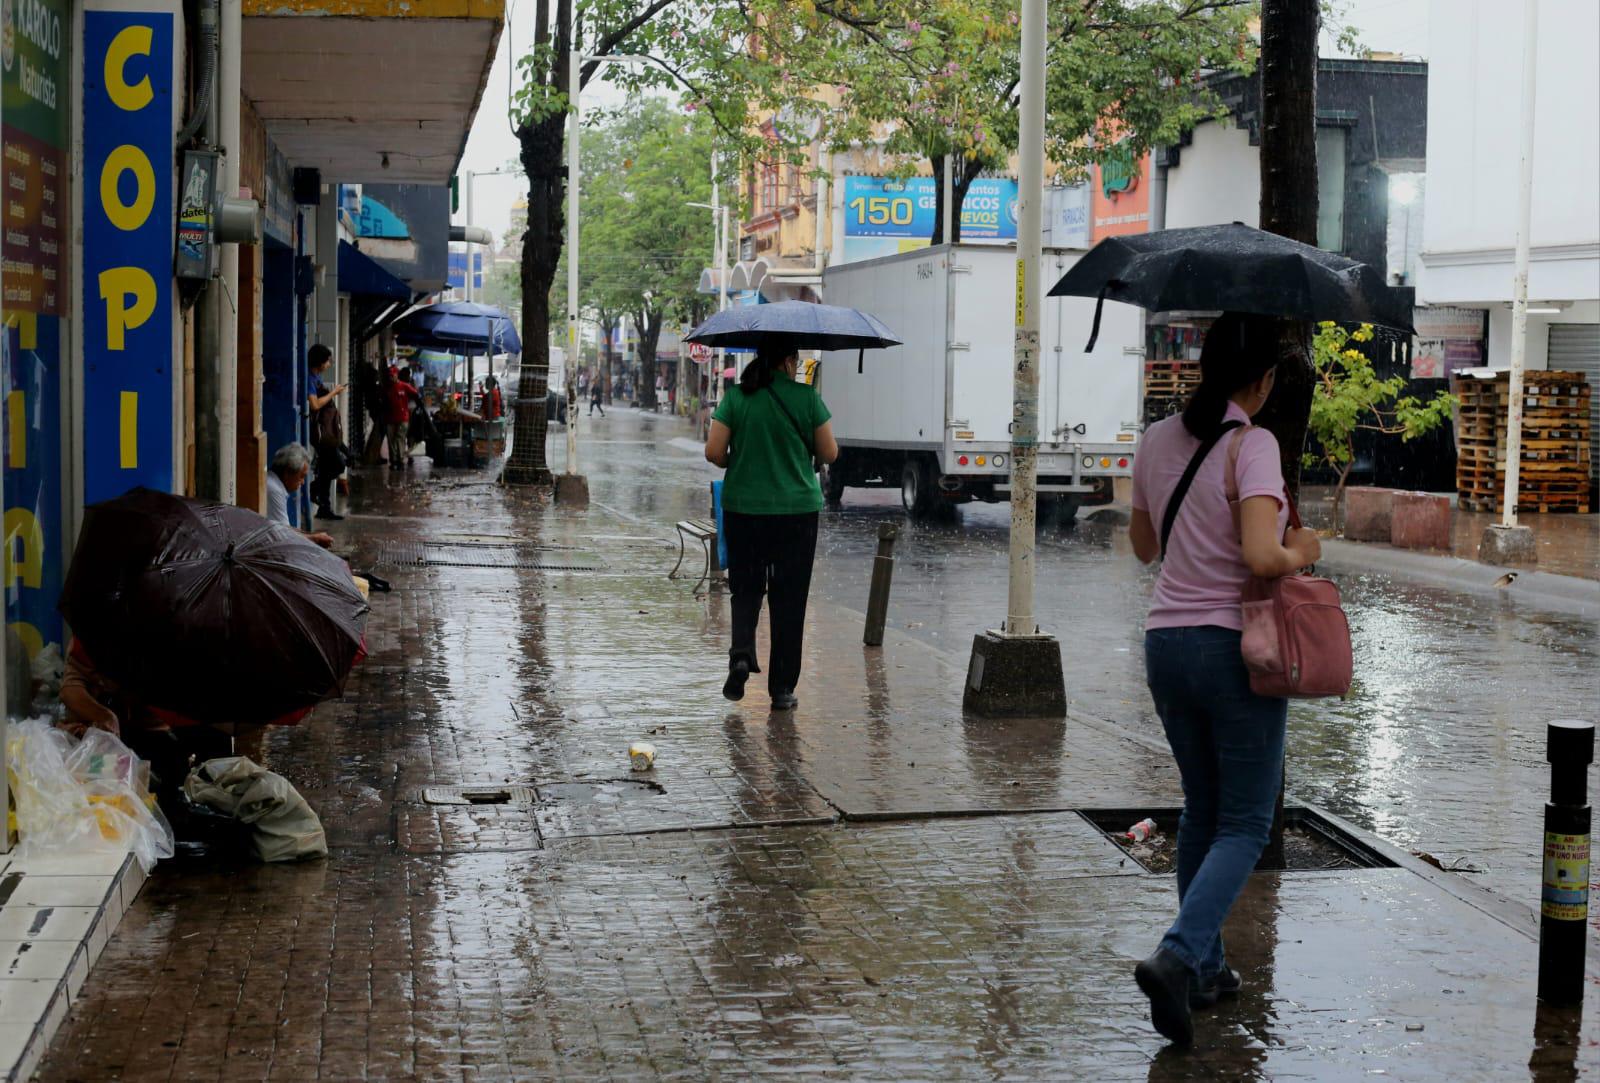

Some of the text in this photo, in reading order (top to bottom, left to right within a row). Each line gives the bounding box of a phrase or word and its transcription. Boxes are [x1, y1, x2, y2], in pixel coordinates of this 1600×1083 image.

[18, 0, 60, 60] KAROLO
[19, 53, 56, 110] Naturista
[849, 196, 912, 225] 150
